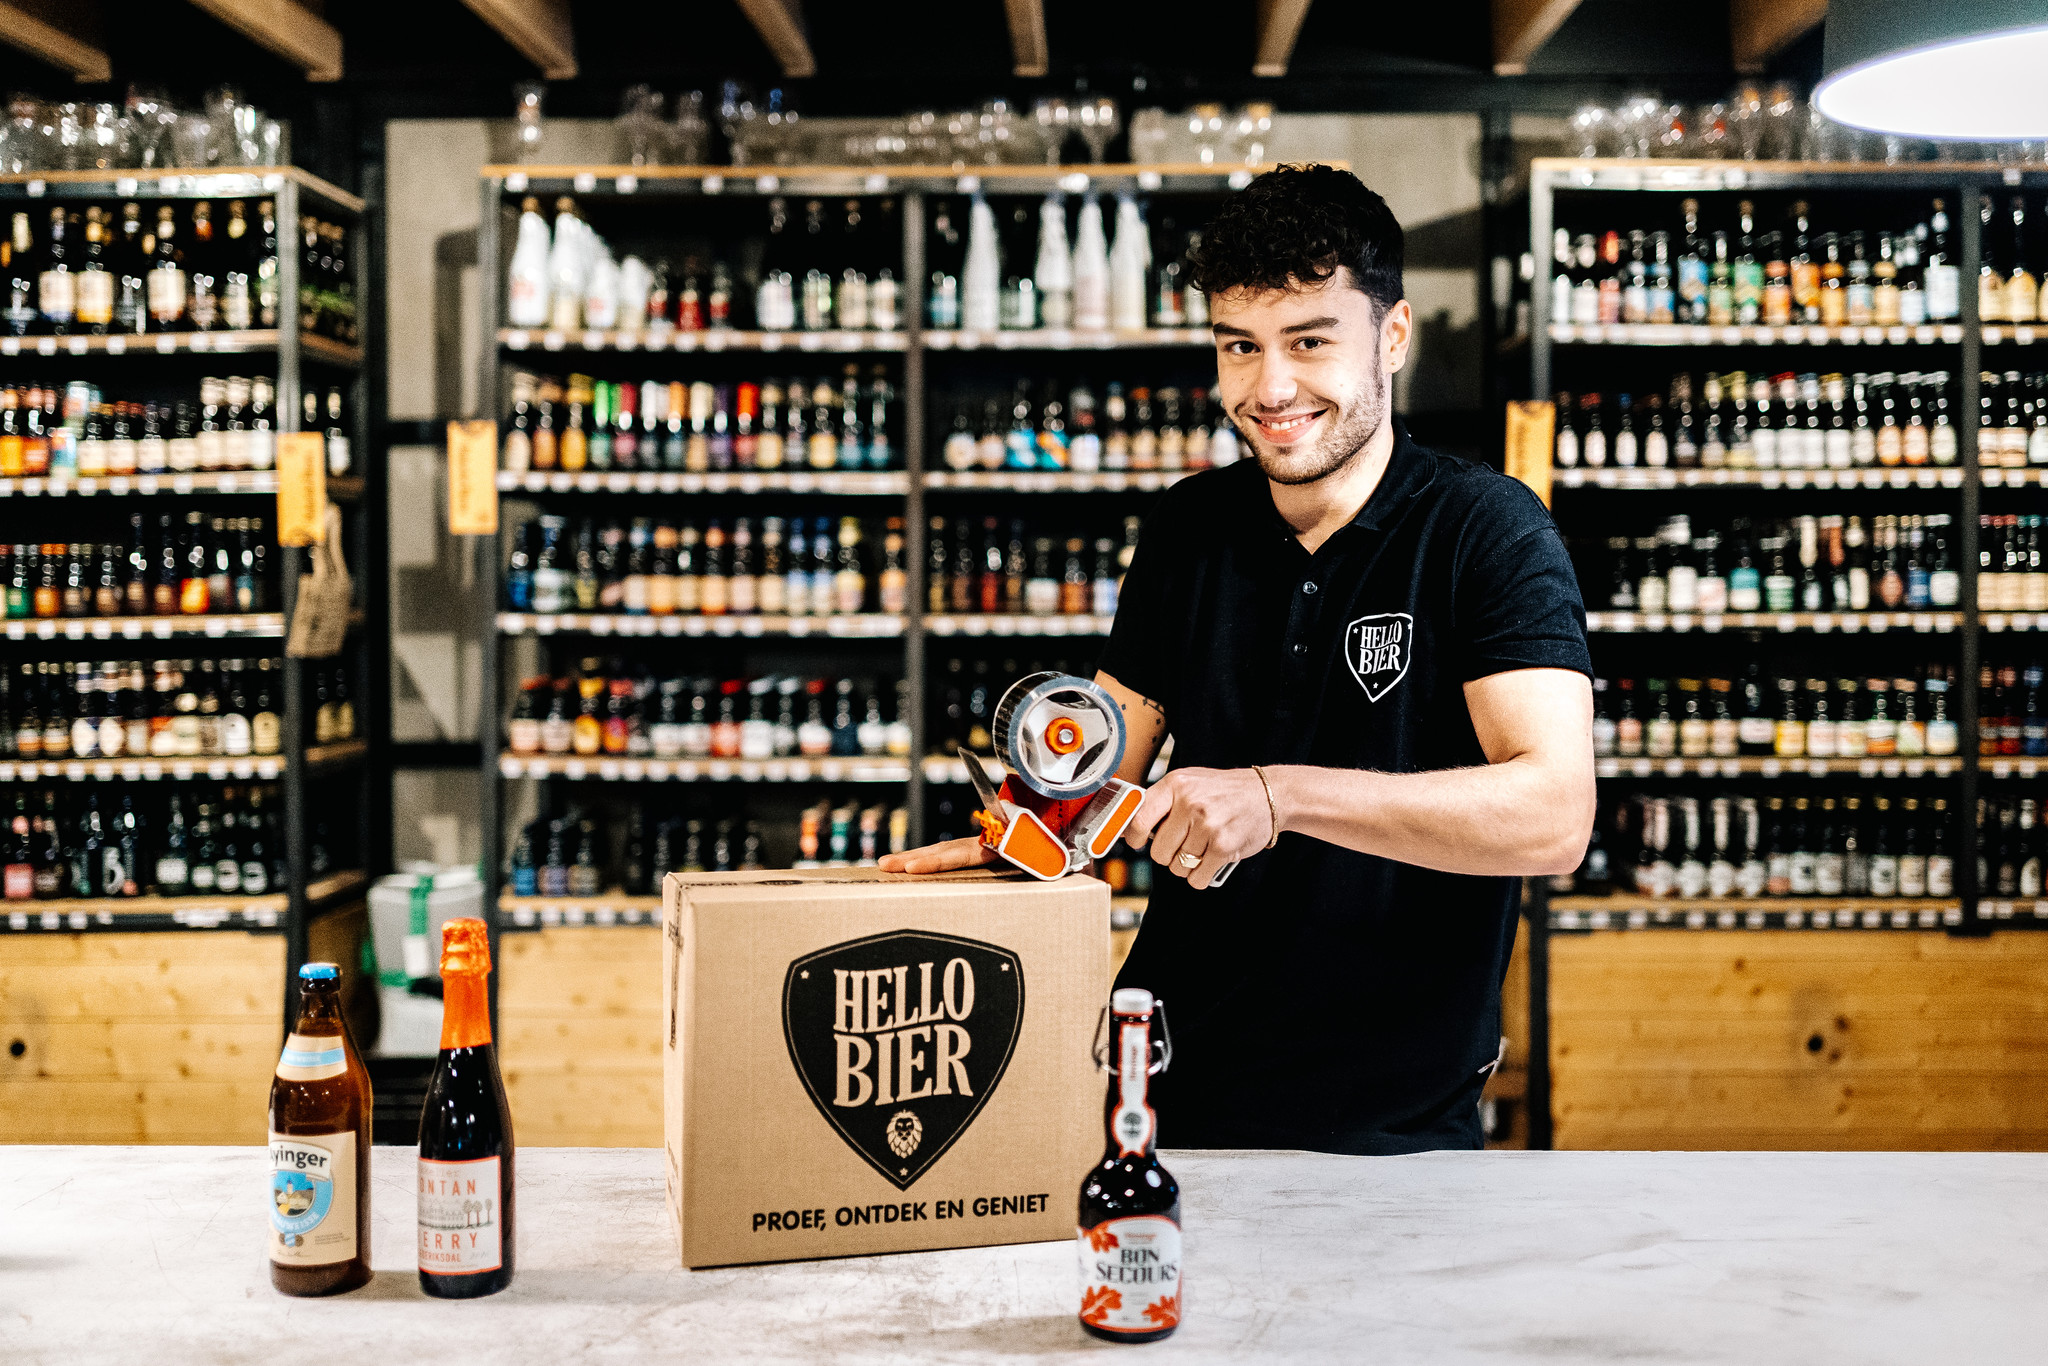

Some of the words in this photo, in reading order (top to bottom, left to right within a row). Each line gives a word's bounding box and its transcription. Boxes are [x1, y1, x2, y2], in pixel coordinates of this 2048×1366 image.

[1360, 620, 1402, 649] HELLO
[1358, 643, 1401, 675] BIER
[833, 957, 975, 1033] HELLO
[832, 1023, 974, 1108] BIER
[752, 1208, 827, 1232] PROEF,
[835, 1202, 927, 1227] ONTDEK
[935, 1199, 964, 1219] EN
[972, 1194, 1050, 1217] GENIET
[420, 1231, 478, 1249] ERRY
[1120, 1248, 1160, 1264] BON
[1096, 1260, 1177, 1284] SECOURS
